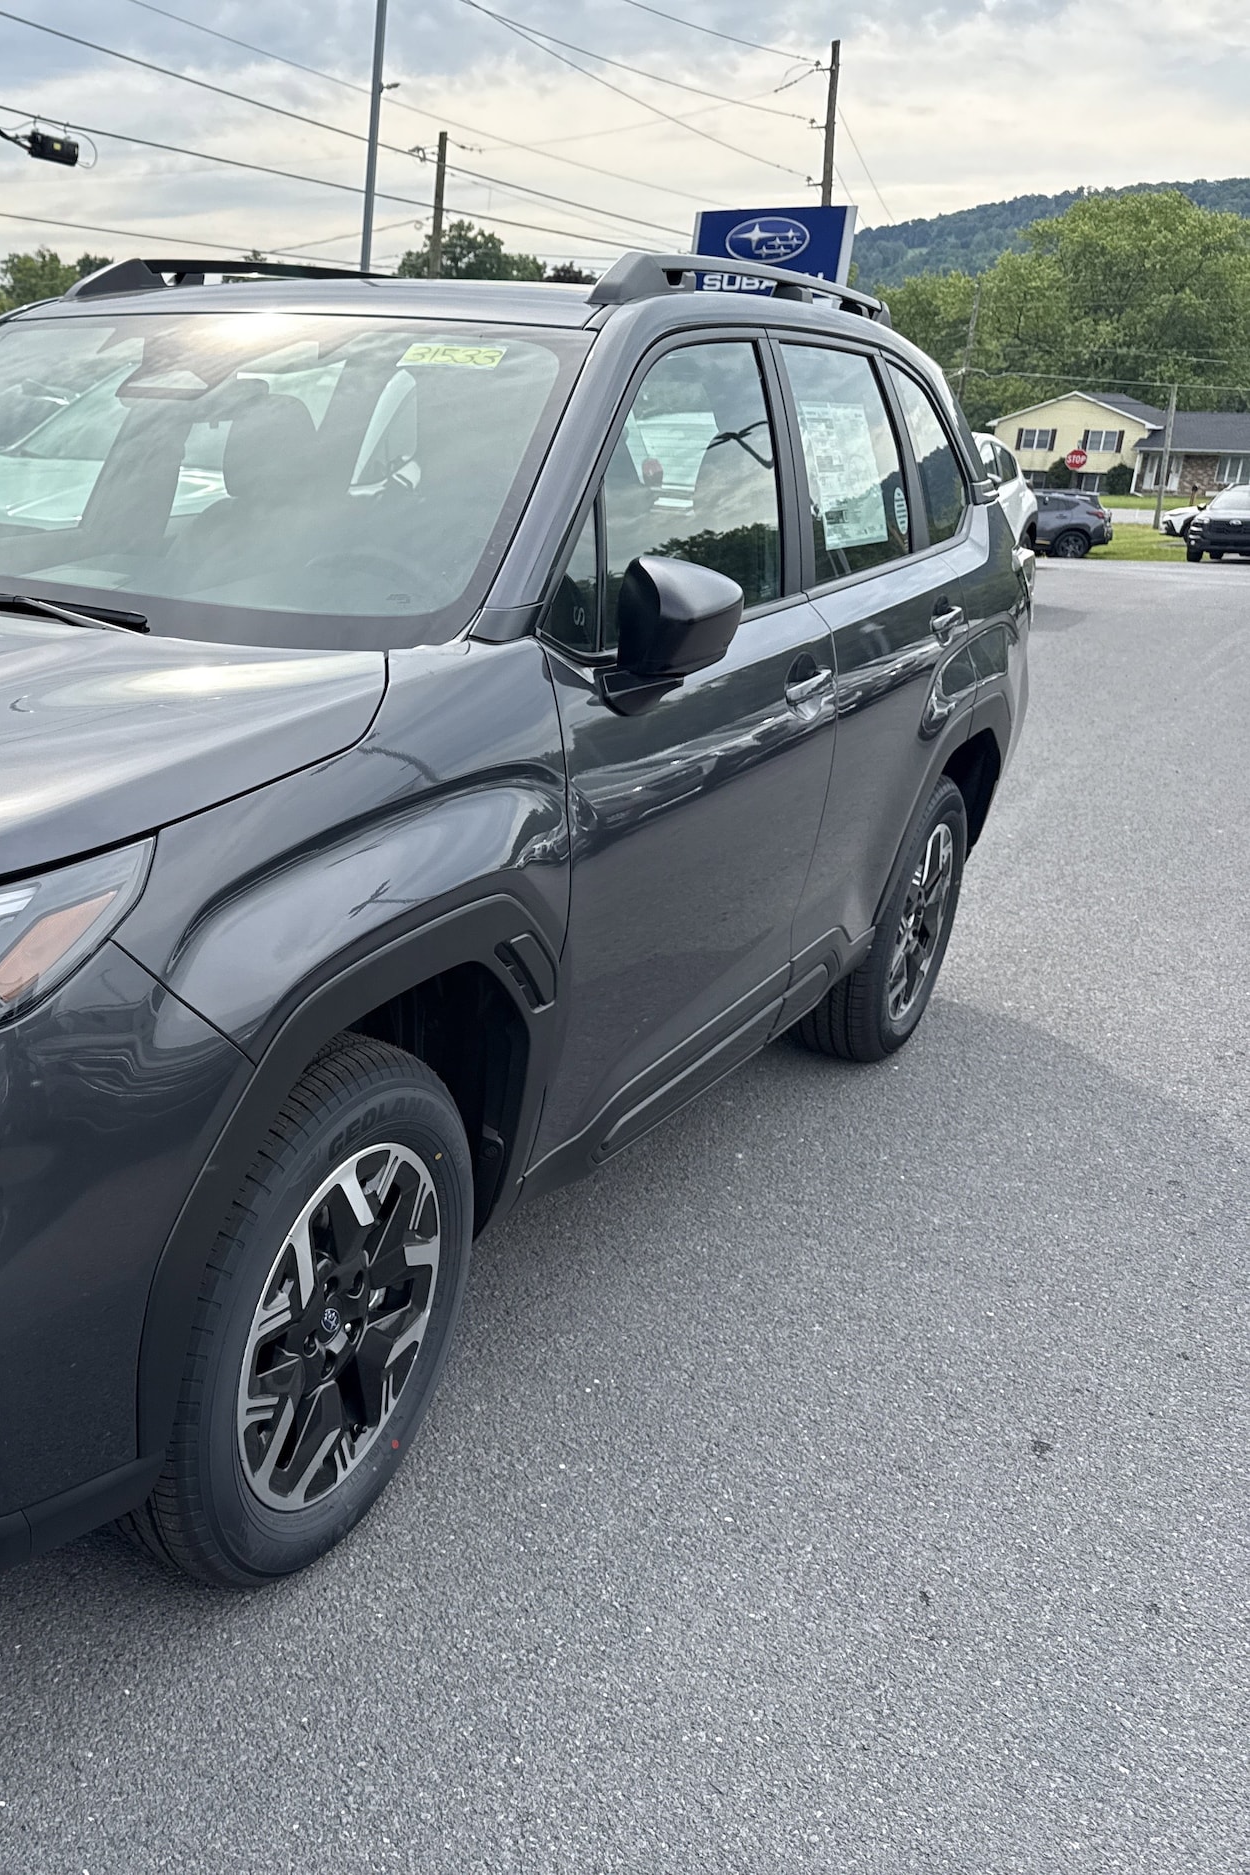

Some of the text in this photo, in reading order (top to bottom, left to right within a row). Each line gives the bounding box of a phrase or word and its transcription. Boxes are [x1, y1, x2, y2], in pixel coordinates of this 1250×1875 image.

[406, 347, 503, 365] 31533
[1067, 455, 1086, 464] STOP
[327, 1096, 452, 1161] GEOLAND
